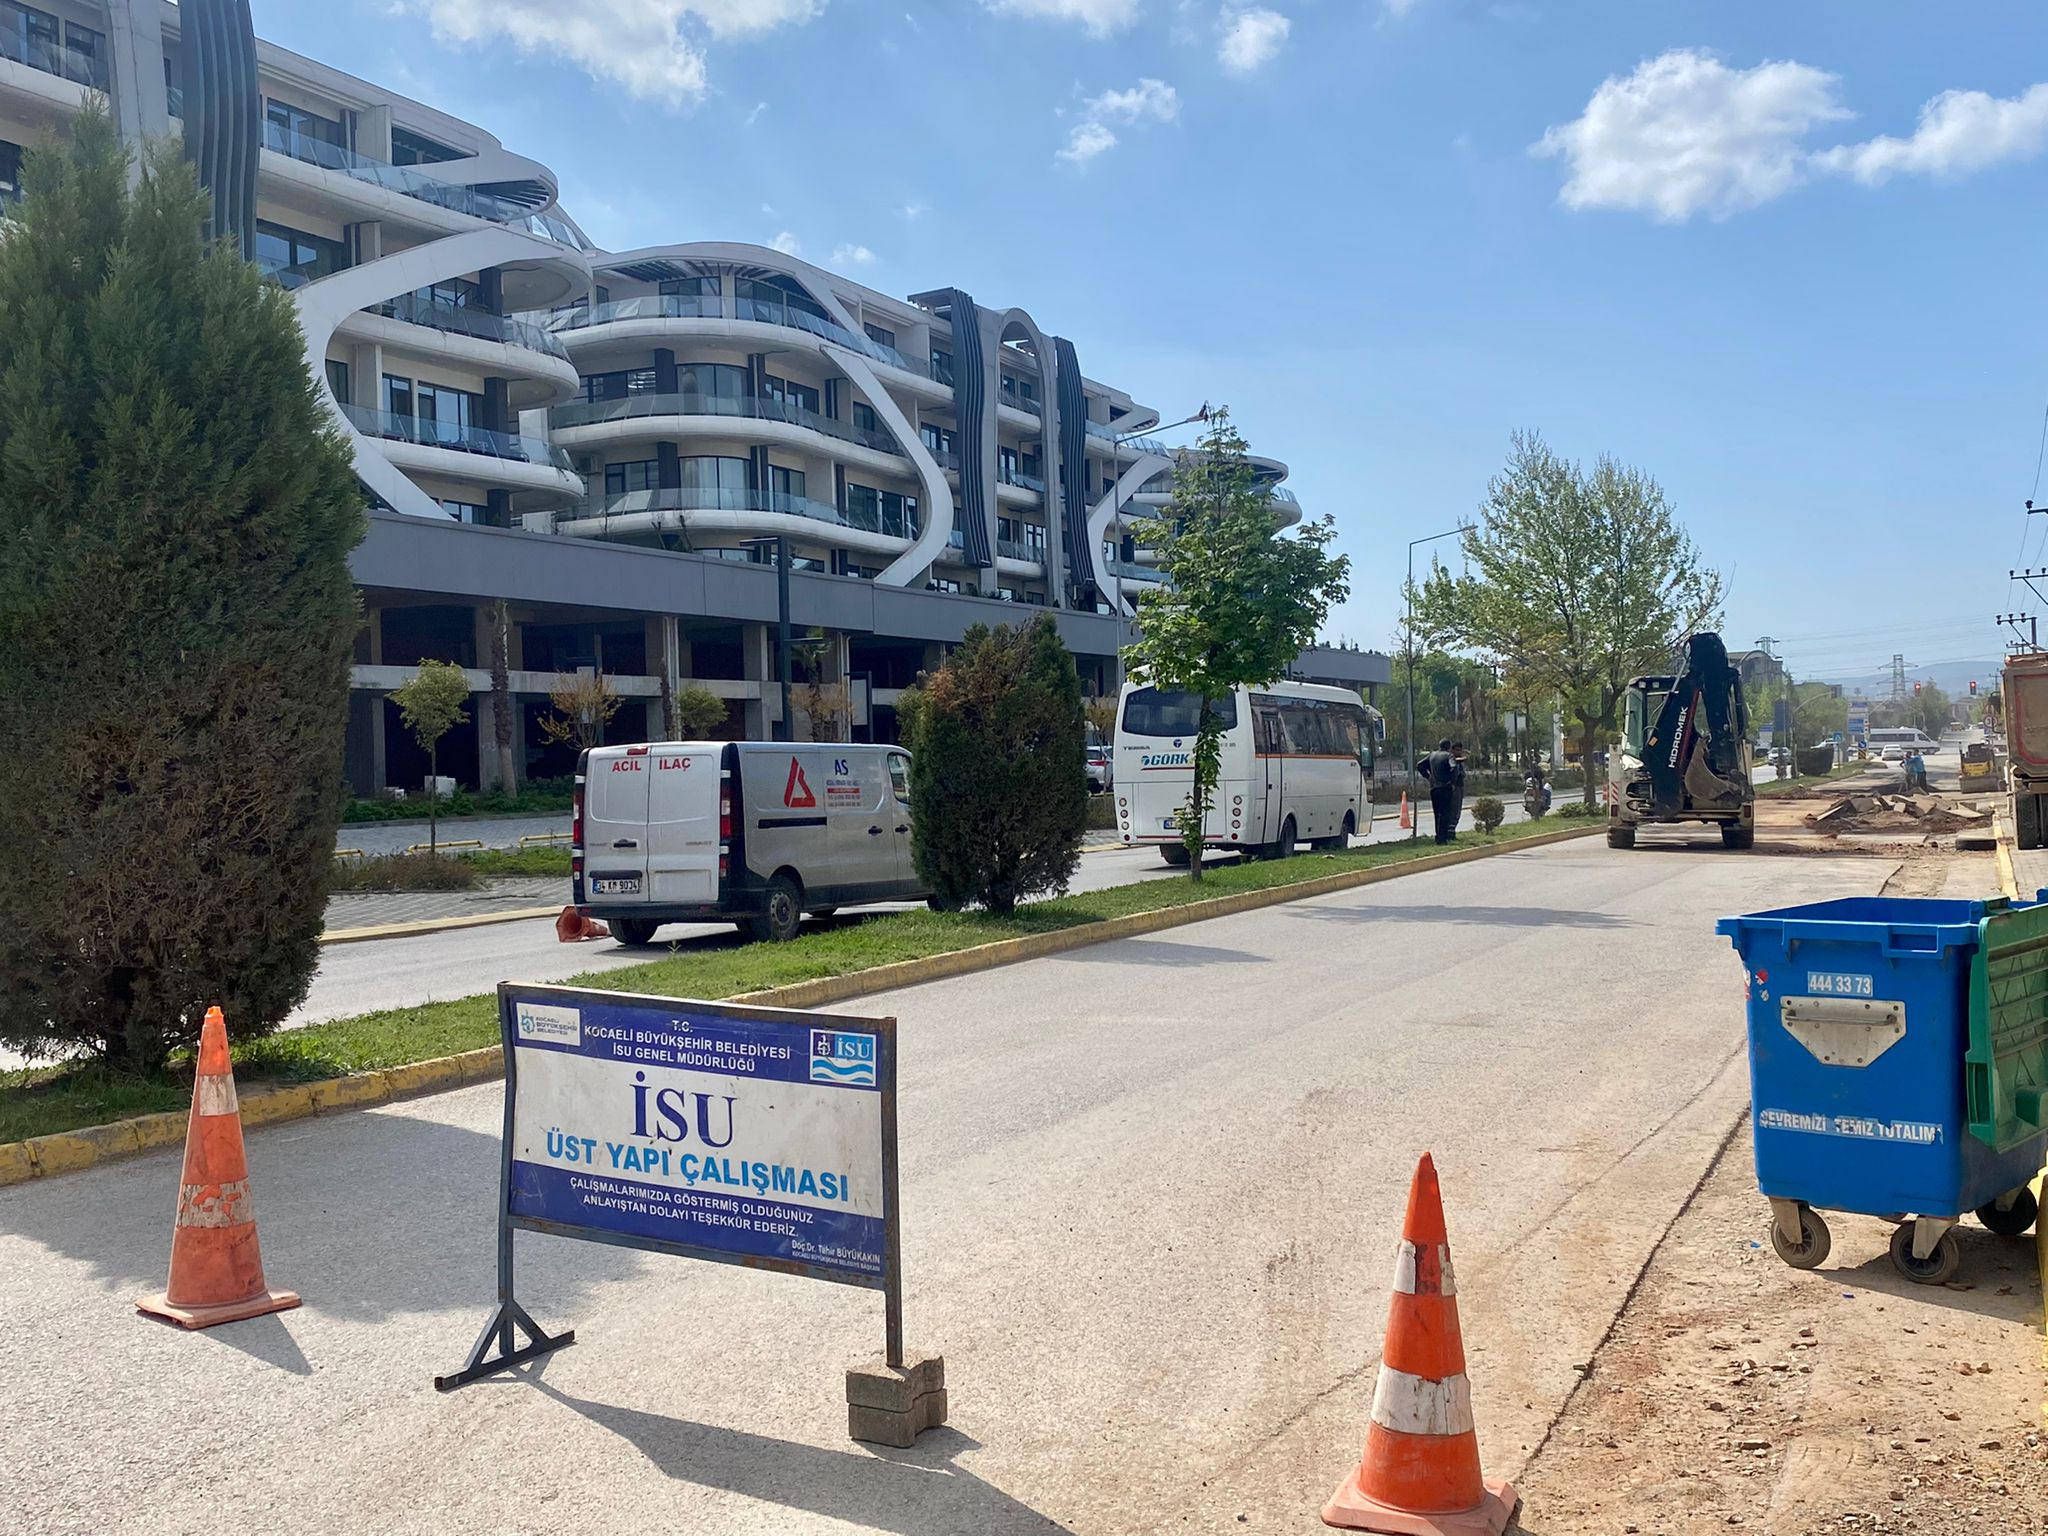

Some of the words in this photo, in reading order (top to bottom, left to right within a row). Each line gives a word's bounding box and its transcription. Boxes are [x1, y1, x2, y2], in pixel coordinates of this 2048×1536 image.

[834, 759, 849, 776] AS
[1809, 975, 1832, 991] 444
[1836, 976, 1851, 992] 33
[1855, 977, 1871, 994] 73
[672, 1020, 694, 1032] T.C.
[584, 1025, 633, 1041] KOCAELİ
[636, 1030, 713, 1051] BÜYÜKŞEHİR
[716, 1039, 791, 1060] BELEDİYESİ
[613, 1042, 632, 1057] İSU
[635, 1046, 675, 1063] GENEL
[677, 1051, 755, 1072] MÜDÜRLÜĞÜ
[837, 1037, 871, 1058] İSU
[629, 1070, 738, 1148] İSU
[547, 1127, 597, 1164] ÜST
[606, 1141, 669, 1176] YAPI
[680, 1153, 849, 1202] ÇALIŞMASI
[570, 1176, 671, 1203] ÇALIŞMALARIMIZDA
[674, 1193, 739, 1214] GÖSTERMİŞ
[742, 1203, 814, 1224] OLDUĞUNUZ
[583, 1194, 647, 1213] ANLAYIŞTAN
[650, 1204, 689, 1221] DOLAYI
[691, 1211, 751, 1230] TEŞEKKÜR
[754, 1221, 799, 1237] EDERİZ.
